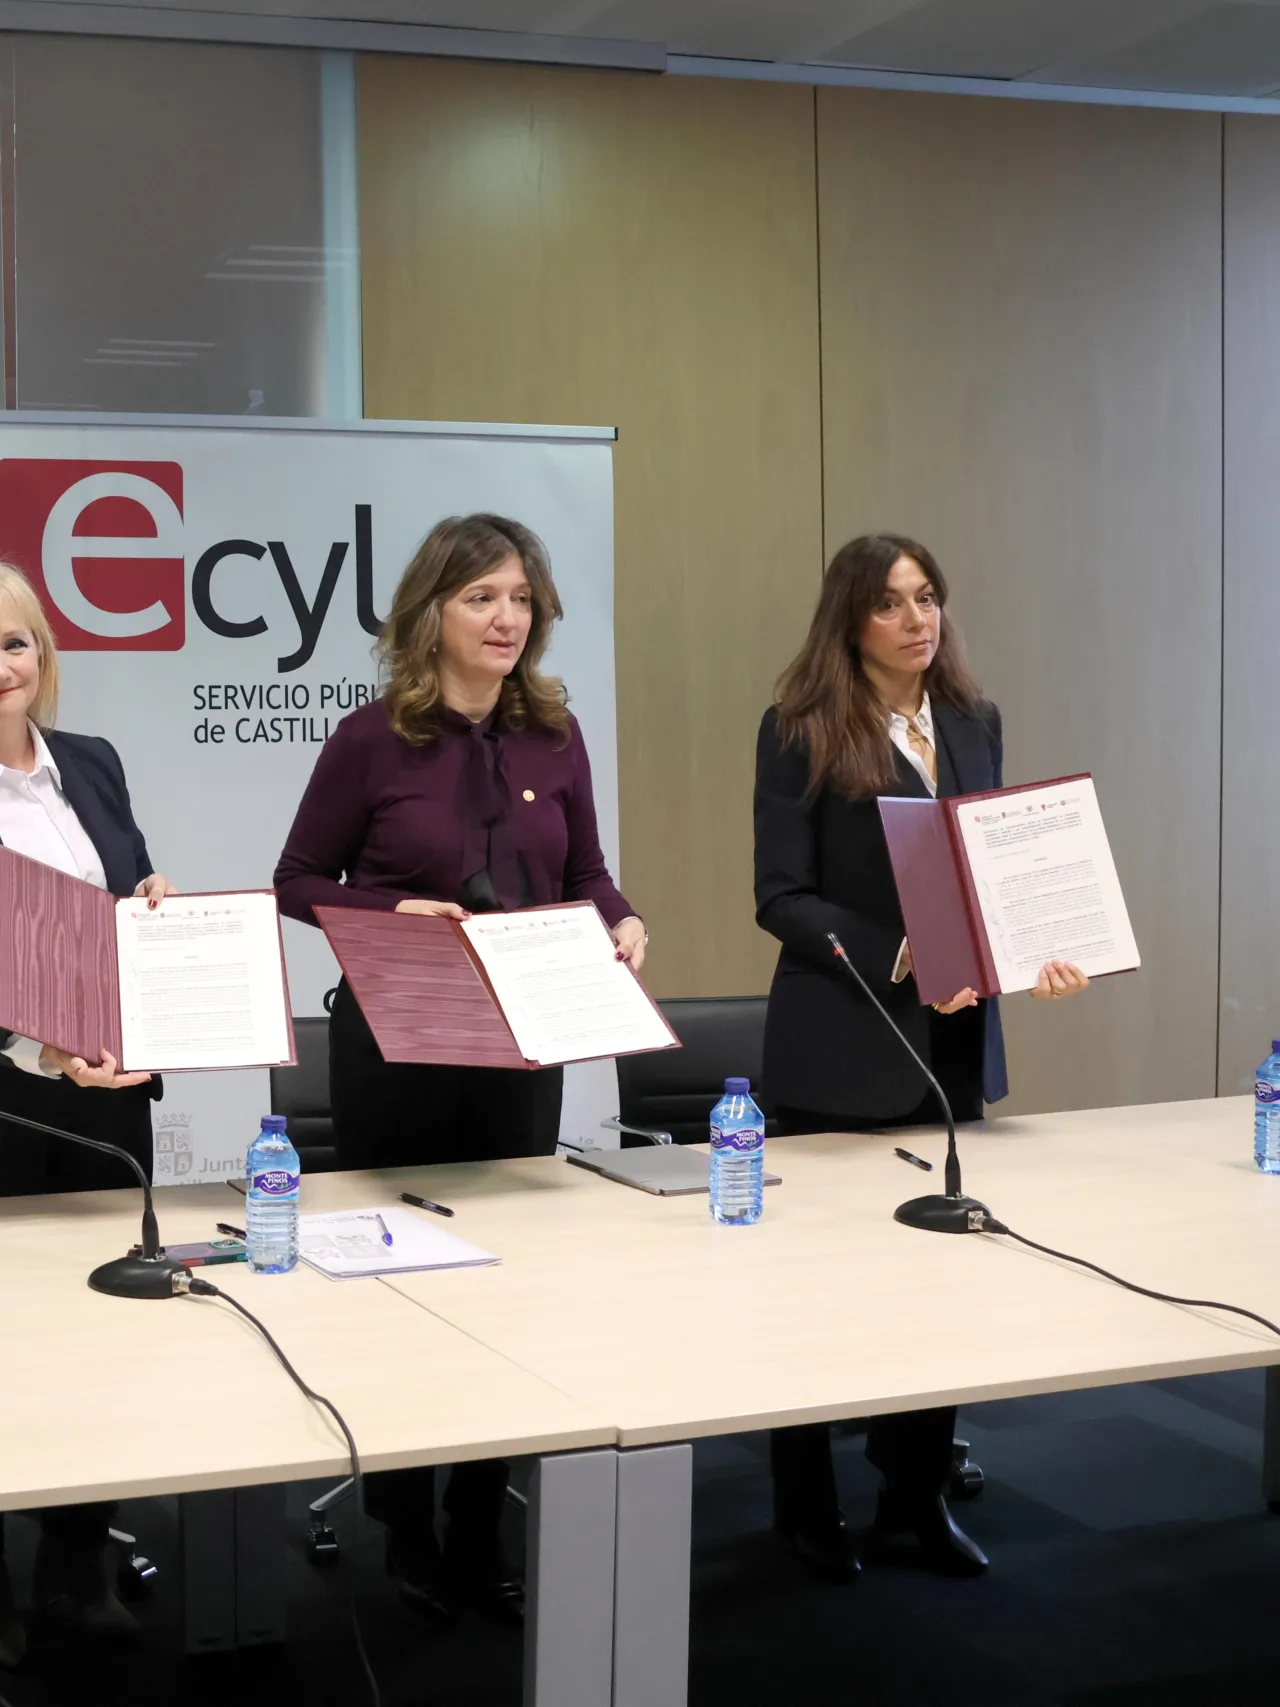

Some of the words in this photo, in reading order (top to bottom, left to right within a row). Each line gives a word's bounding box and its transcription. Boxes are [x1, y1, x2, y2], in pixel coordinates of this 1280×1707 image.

[193, 684, 310, 711] SERVICIO
[193, 718, 225, 743] de
[235, 718, 329, 743] CASTILL
